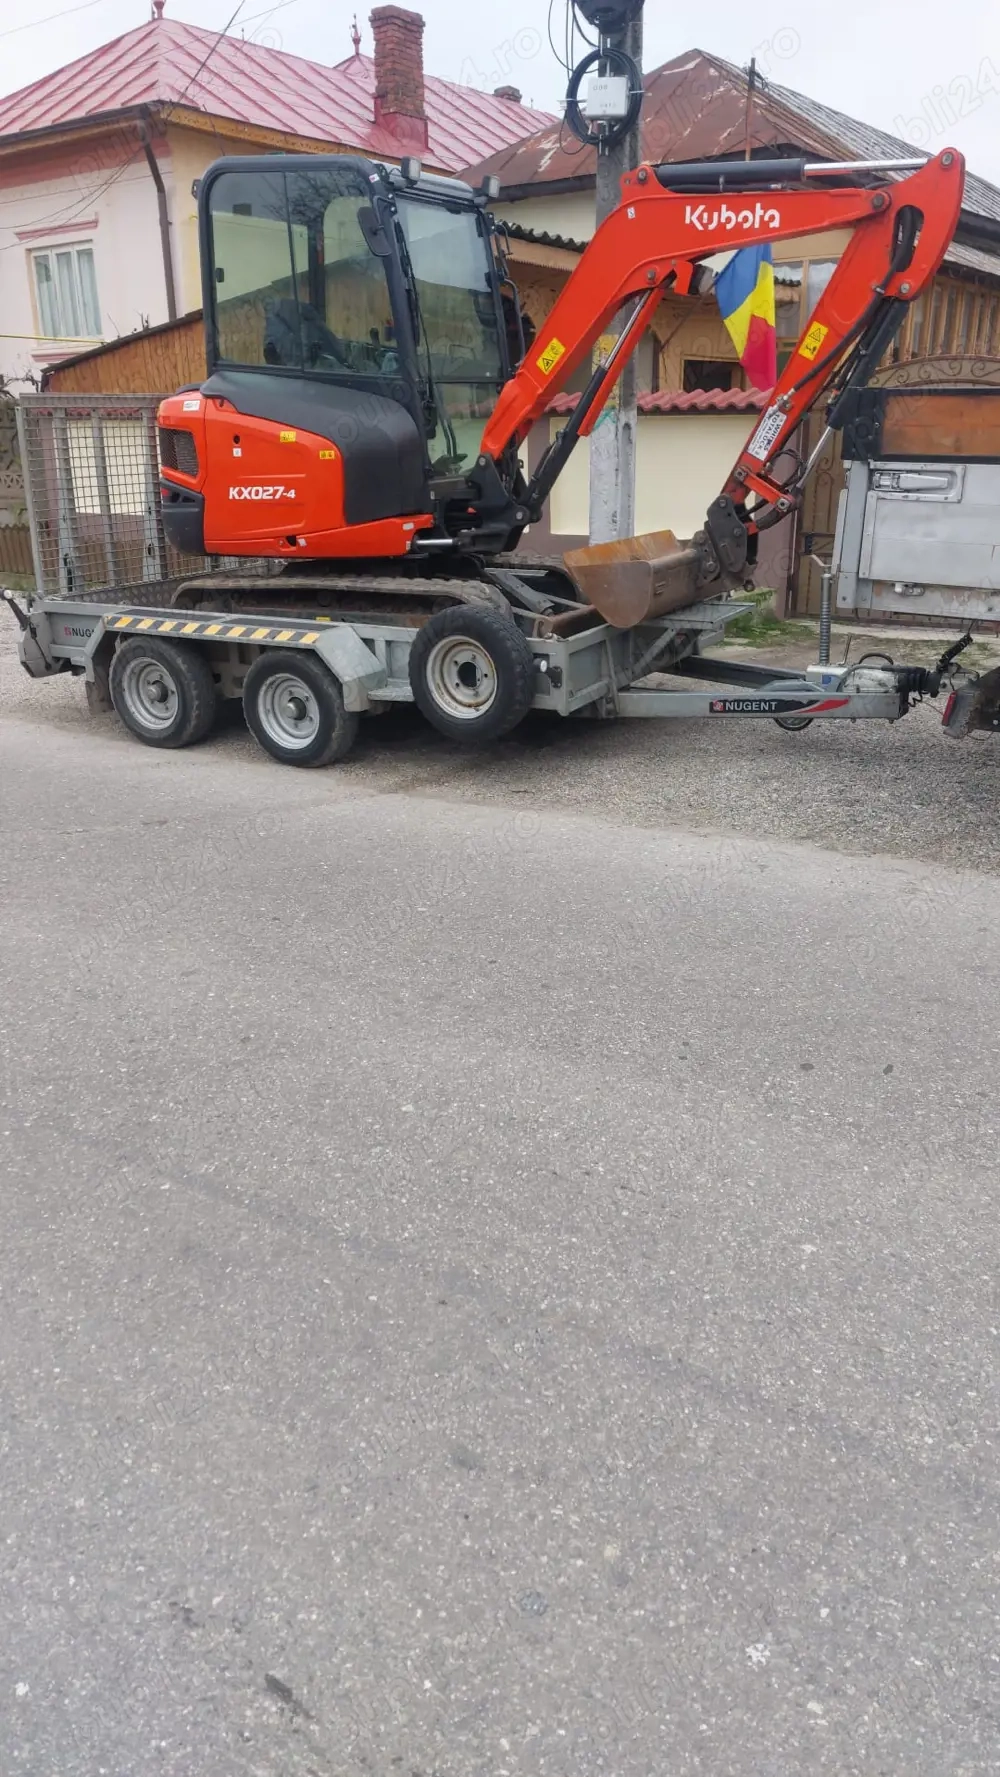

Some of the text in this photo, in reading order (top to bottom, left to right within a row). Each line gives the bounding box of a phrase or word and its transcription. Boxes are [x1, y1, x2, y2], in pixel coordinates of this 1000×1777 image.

[685, 202, 780, 231] Kubota
[228, 485, 296, 500] KX027-4
[71, 627, 95, 638] NUG
[725, 701, 778, 711] NUGENT
